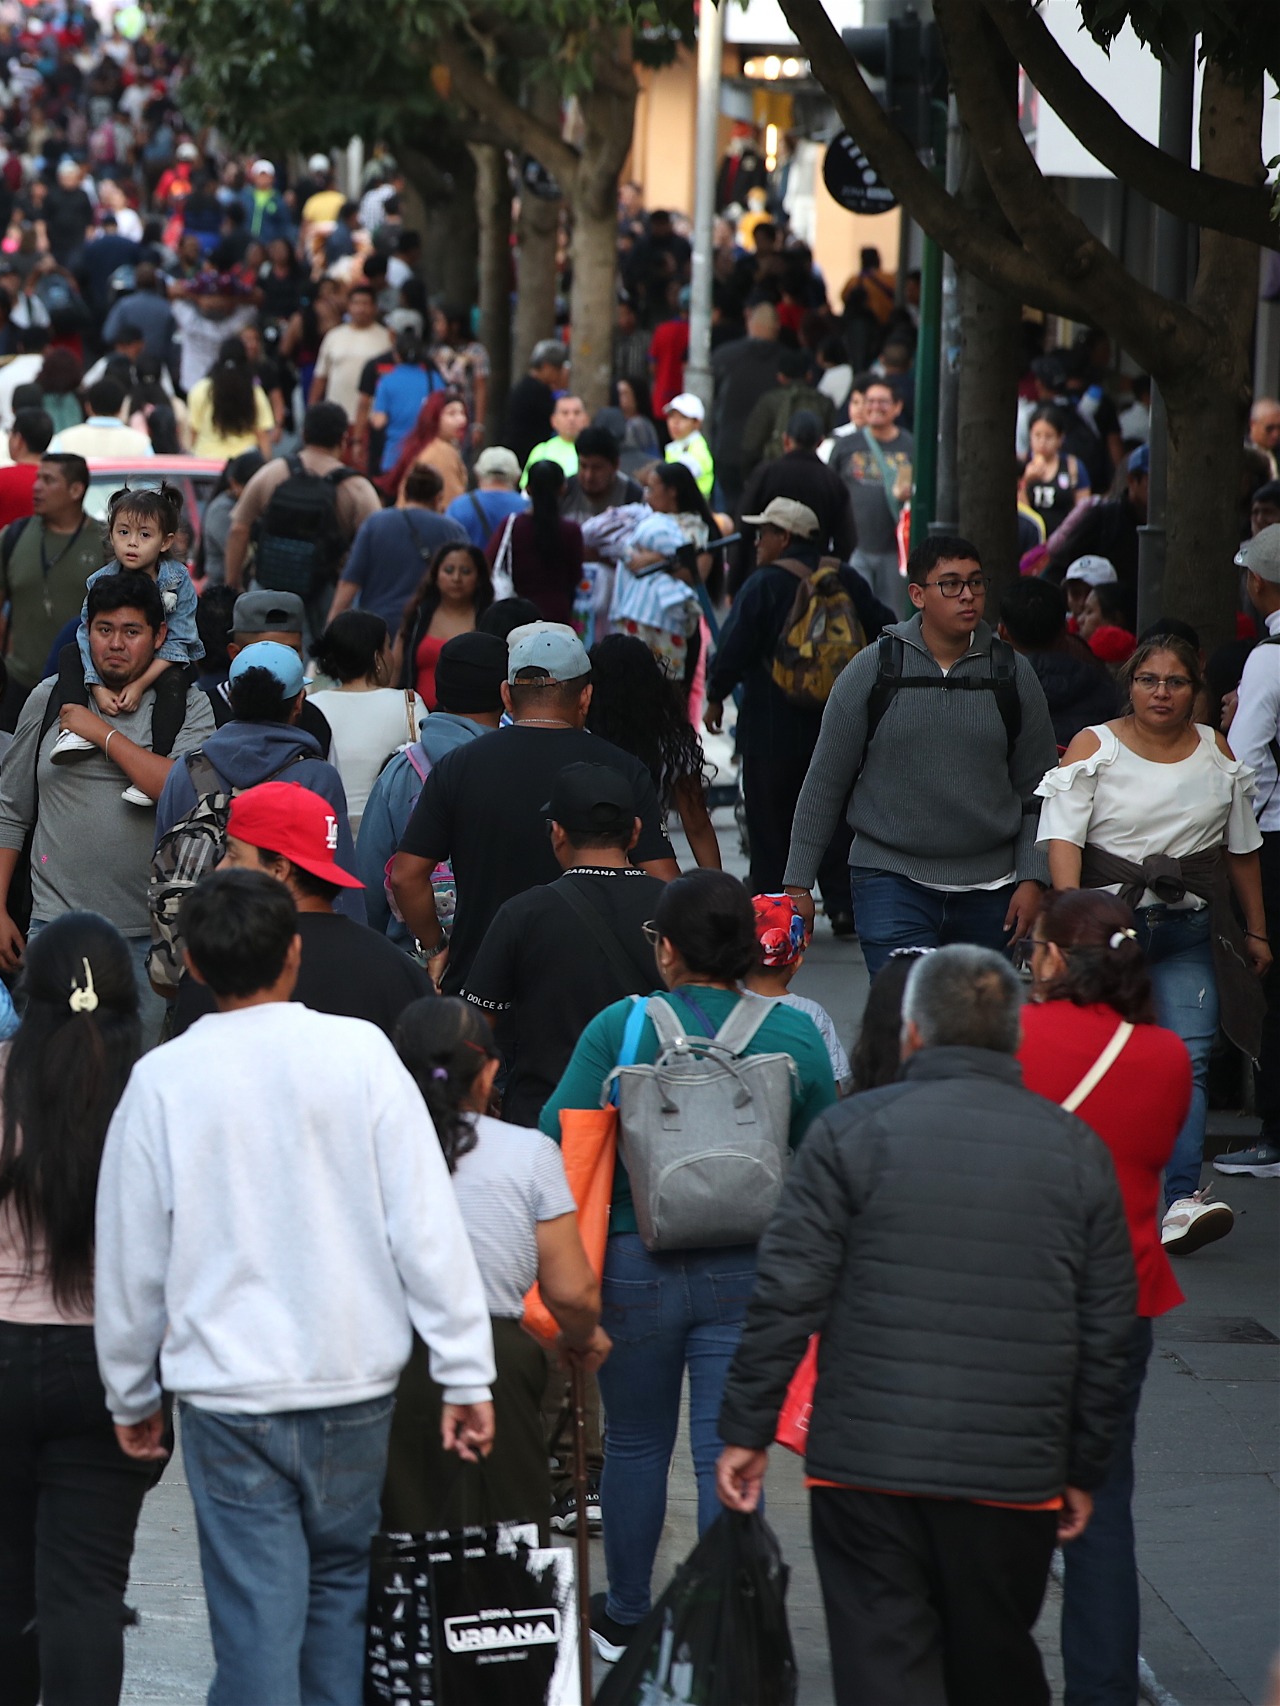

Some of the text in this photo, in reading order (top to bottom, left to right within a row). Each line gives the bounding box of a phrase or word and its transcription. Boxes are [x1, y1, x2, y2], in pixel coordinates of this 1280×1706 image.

[1033, 486, 1055, 508] 13
[324, 815, 338, 849] LA
[467, 993, 496, 1010] DOLCE
[451, 1620, 558, 1645] URBANA
